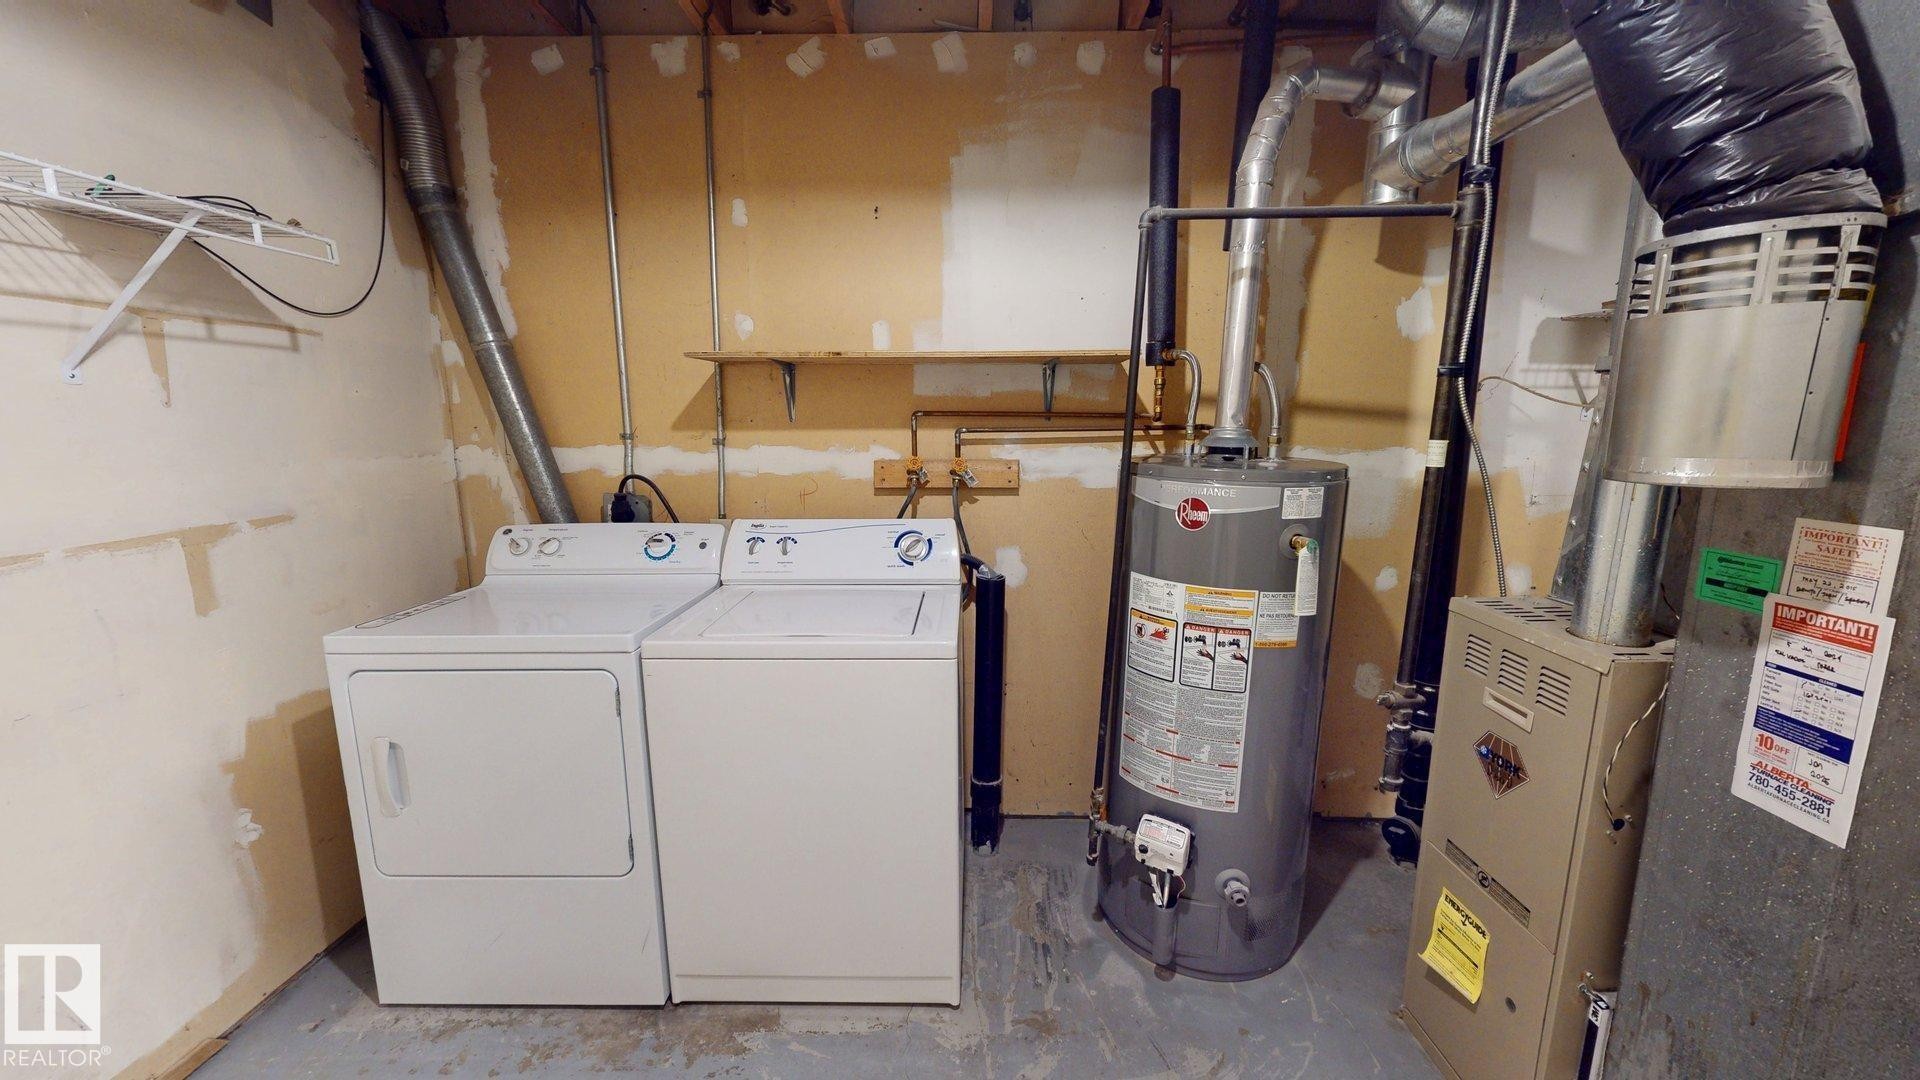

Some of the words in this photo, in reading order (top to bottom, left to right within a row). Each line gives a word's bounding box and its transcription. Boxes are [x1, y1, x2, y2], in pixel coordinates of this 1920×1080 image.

[1179, 498, 1208, 525] Rheem
[1803, 530, 1883, 550] IMPORTANT!
[1816, 545, 1864, 559] SAFETY
[1776, 604, 1875, 640] IMPORTANT!
[1774, 745, 1790, 755] OFF
[1489, 750, 1521, 780] YORK
[1753, 760, 1811, 788] ALBERTA
[1748, 771, 1832, 818] 780-455-2881
[1750, 765, 1790, 786] FURNACE
[1790, 783, 1835, 806] CLEANING
